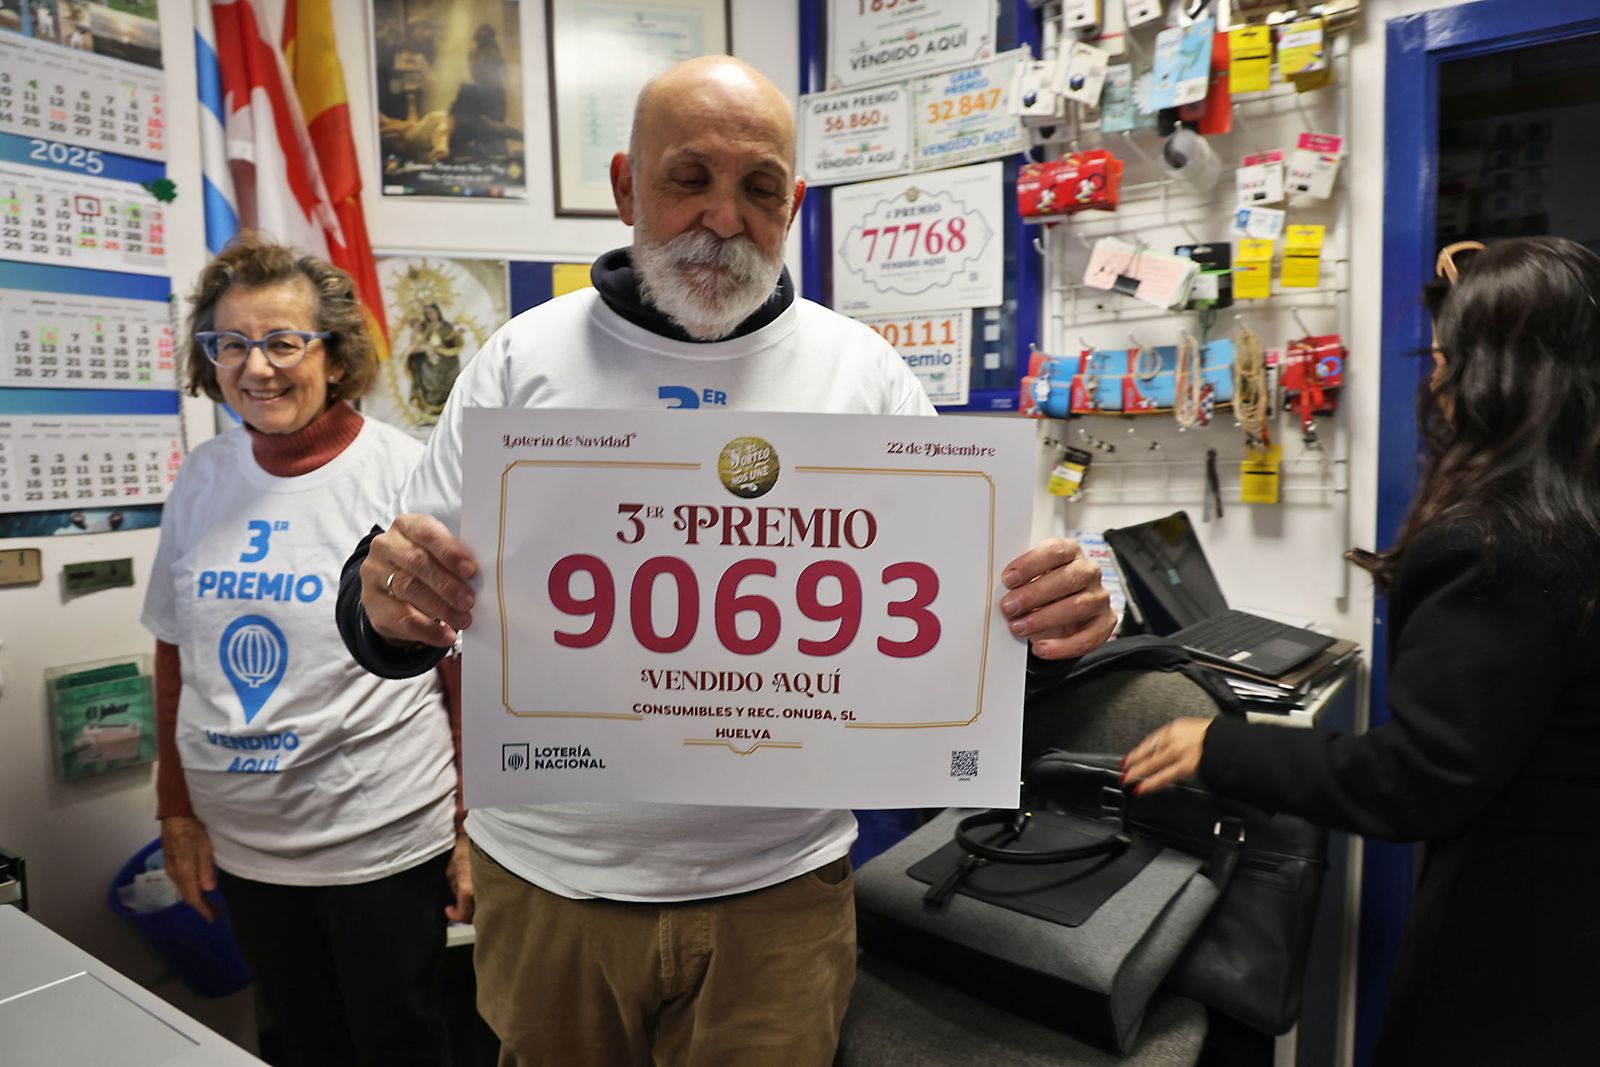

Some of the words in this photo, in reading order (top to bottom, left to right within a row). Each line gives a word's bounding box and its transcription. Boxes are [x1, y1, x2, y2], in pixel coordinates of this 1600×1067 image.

[850, 44, 919, 70] VENDIDO
[925, 27, 968, 54] AQUÍ
[950, 68, 982, 83] GRAN
[814, 102, 848, 113] GRAN
[853, 90, 898, 106] PREMIO
[923, 135, 980, 156] VENDIDO
[30, 140, 103, 174] 2025
[816, 155, 863, 169] VENDIDO
[895, 203, 941, 218] PREMIO
[861, 217, 966, 262] 77768
[869, 319, 954, 348] 0111
[503, 434, 554, 448] Lotería
[556, 435, 573, 447] de
[887, 442, 903, 454] 22
[905, 442, 922, 454] de
[924, 443, 996, 457] Diciembre
[673, 505, 878, 549] PREMIO
[198, 571, 323, 603] PREMIO
[547, 553, 942, 659] 90693
[641, 669, 763, 693] VENDIDO
[772, 668, 841, 698] AQUÍ
[633, 703, 732, 718] CONSUMIBLES
[736, 707, 744, 717] Y
[748, 707, 780, 718] REC.
[782, 708, 837, 721] ONUBA,
[840, 710, 856, 721] SL
[206, 729, 299, 752] VENDIDO
[716, 728, 771, 739] HUELVA
[534, 744, 592, 757] LOTERÍA
[227, 755, 280, 773] AQUÍ
[534, 758, 606, 770] NACIONAL
